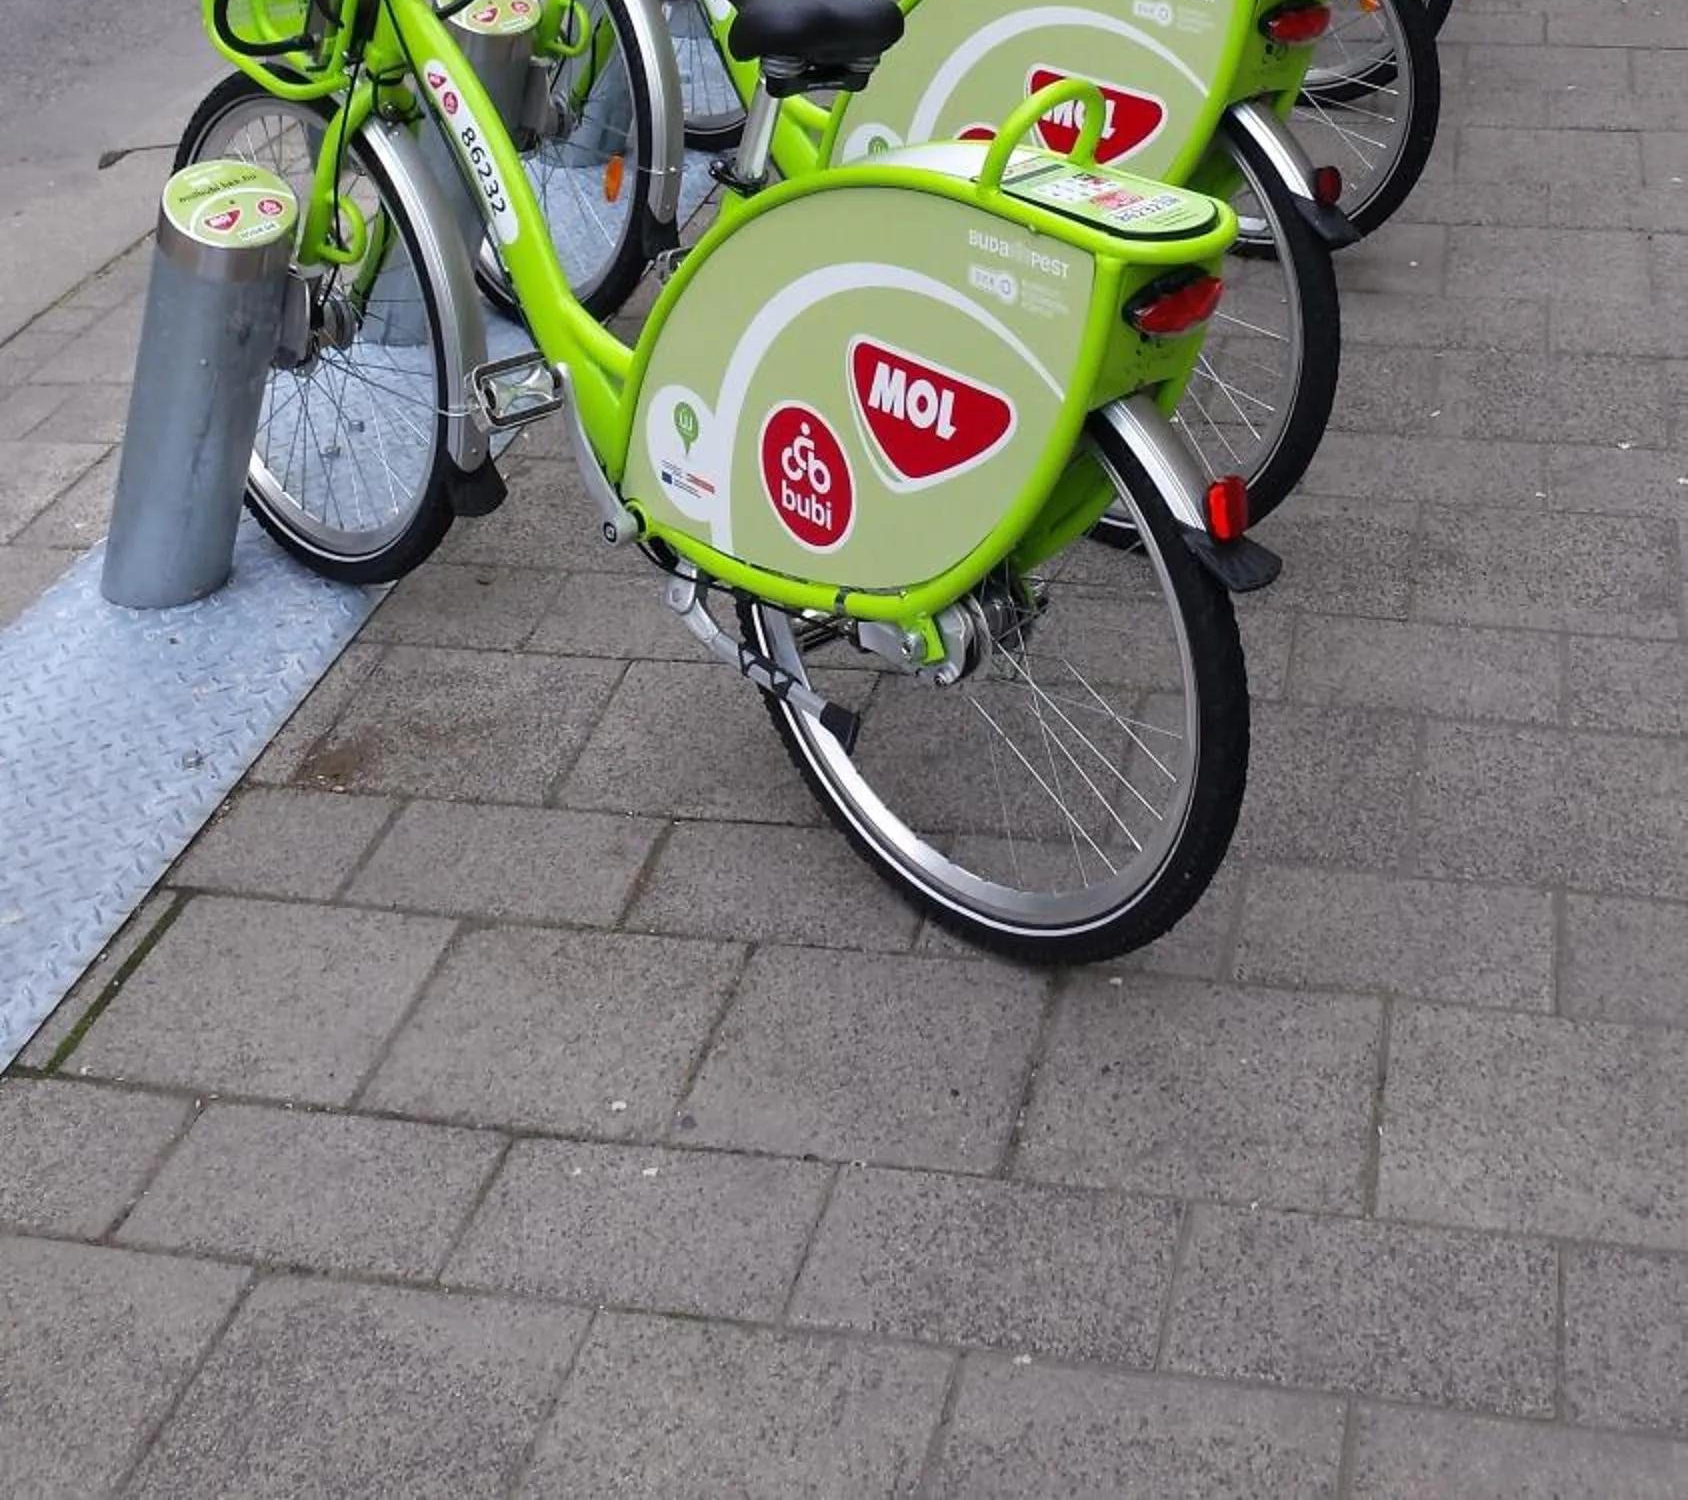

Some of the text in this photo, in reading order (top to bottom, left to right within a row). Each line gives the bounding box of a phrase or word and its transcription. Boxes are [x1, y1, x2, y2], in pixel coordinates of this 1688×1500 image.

[460, 126, 507, 216] 86232
[867, 360, 957, 440] MOL
[781, 479, 832, 531] bubi
